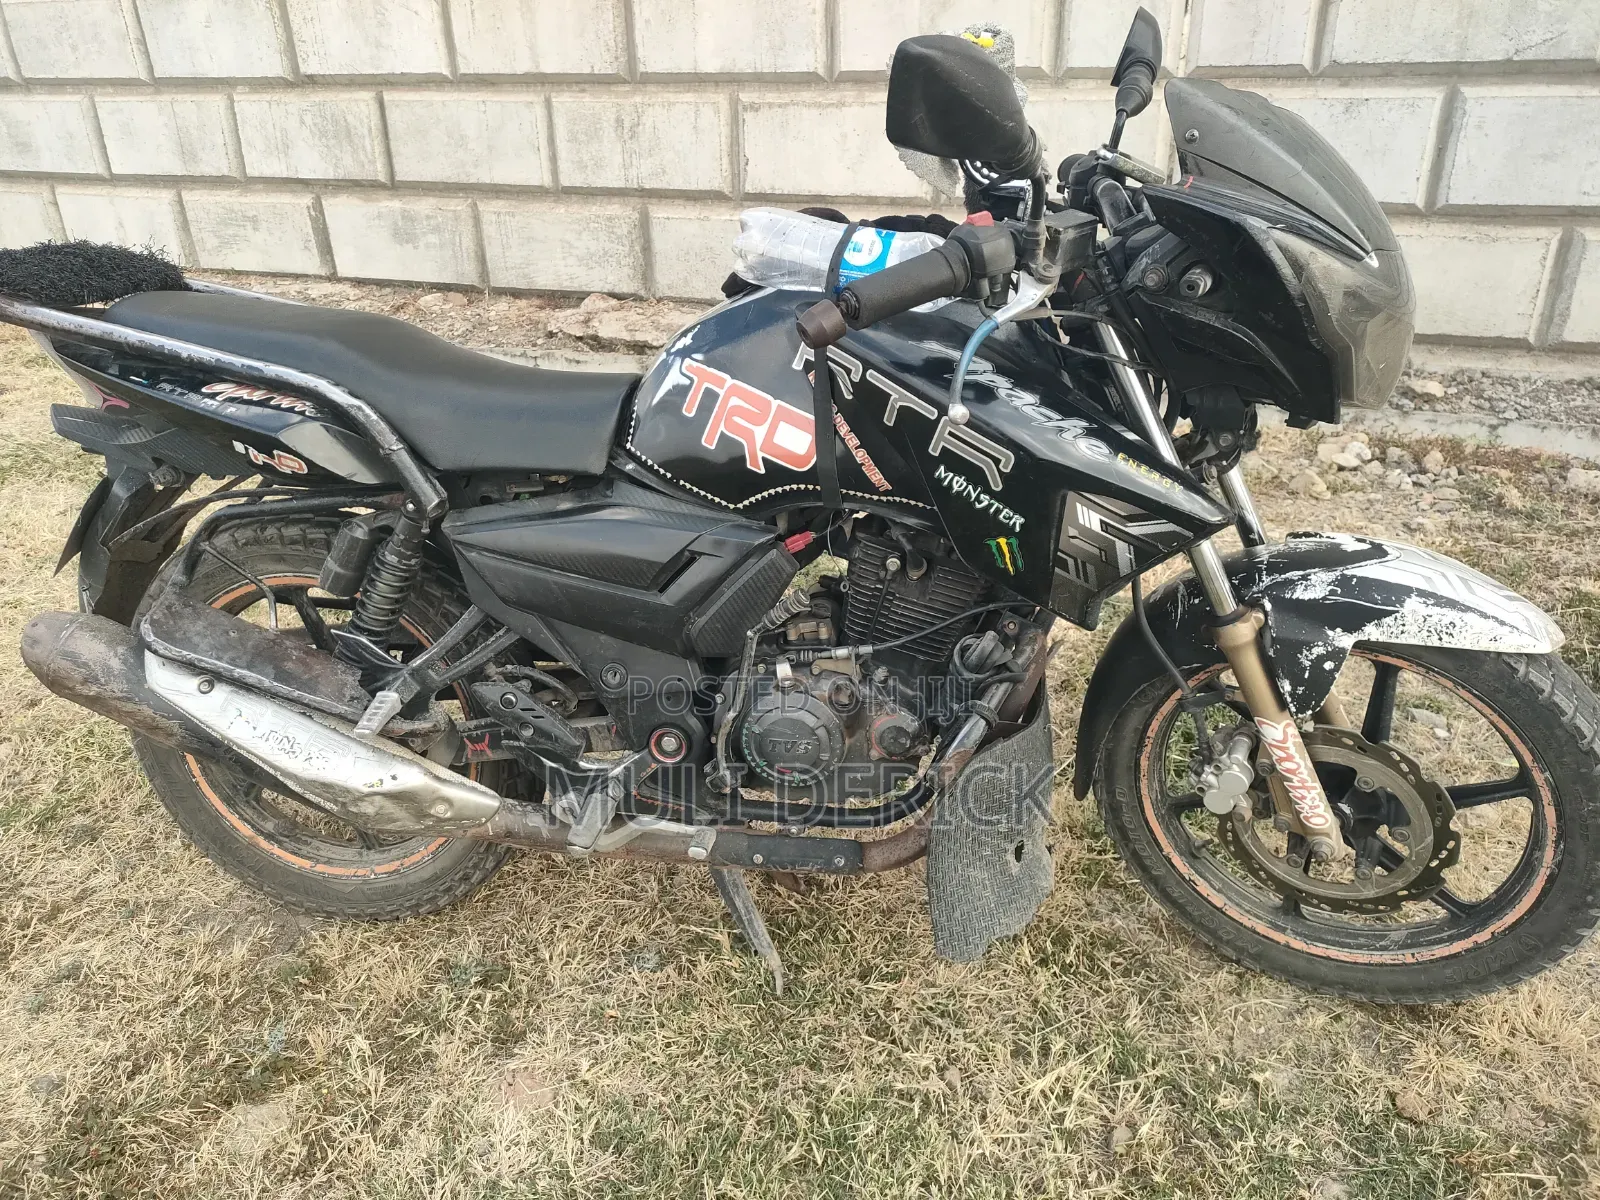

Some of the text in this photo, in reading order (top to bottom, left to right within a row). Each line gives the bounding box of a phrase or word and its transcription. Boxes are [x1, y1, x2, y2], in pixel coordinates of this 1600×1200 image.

[681, 358, 818, 474] TRD
[832, 412, 893, 493] DEVELOPMENT
[1116, 452, 1184, 494] ENERGY
[768, 739, 813, 755] TVS
